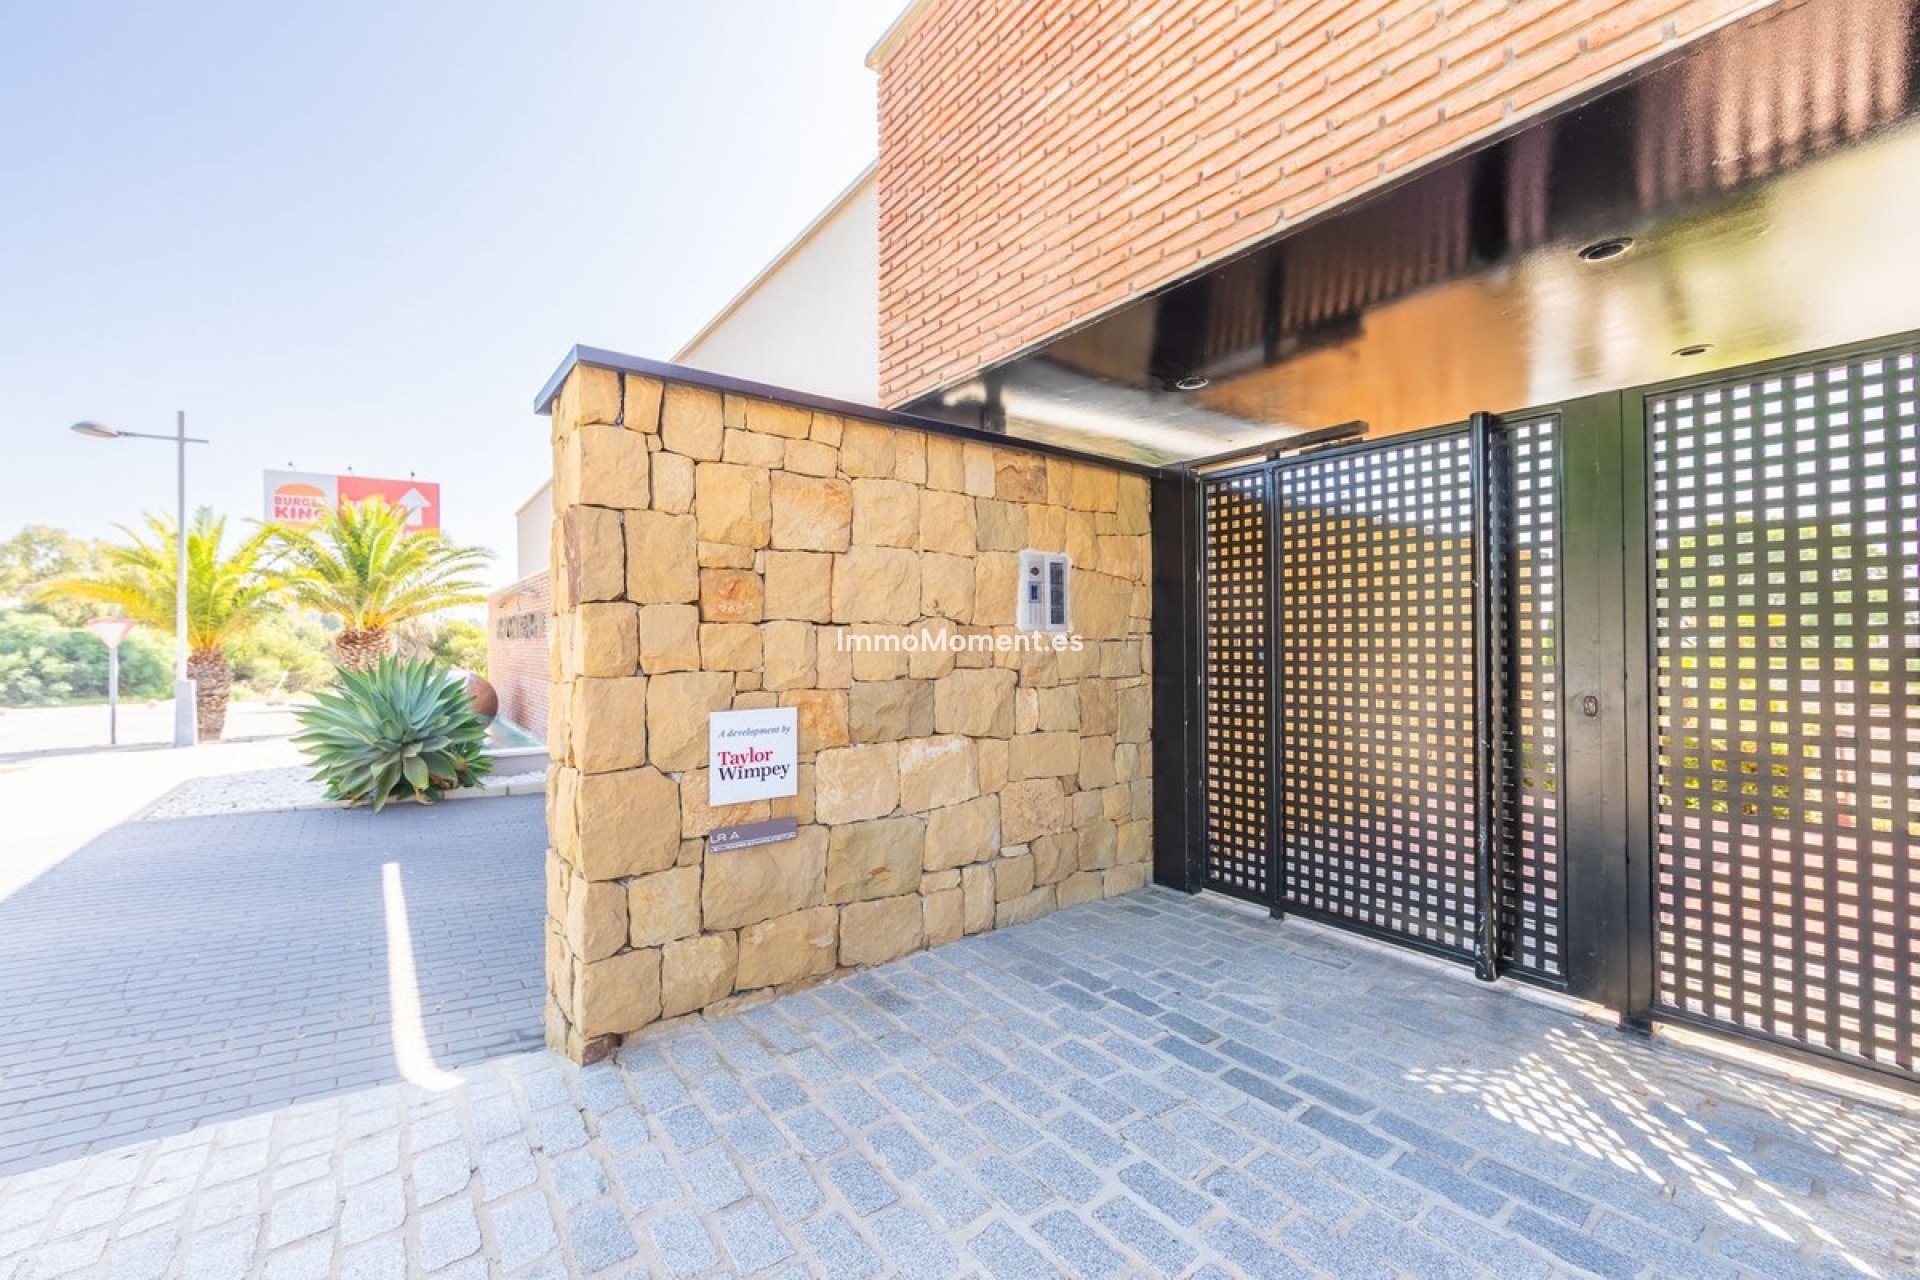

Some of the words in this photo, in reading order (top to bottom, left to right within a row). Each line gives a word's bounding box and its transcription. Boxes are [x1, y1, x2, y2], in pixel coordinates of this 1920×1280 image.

[718, 729, 726, 738] A
[726, 726, 780, 738] development
[780, 725, 791, 736] by
[717, 747, 774, 768] Taylor
[718, 762, 791, 782] Wimpey
